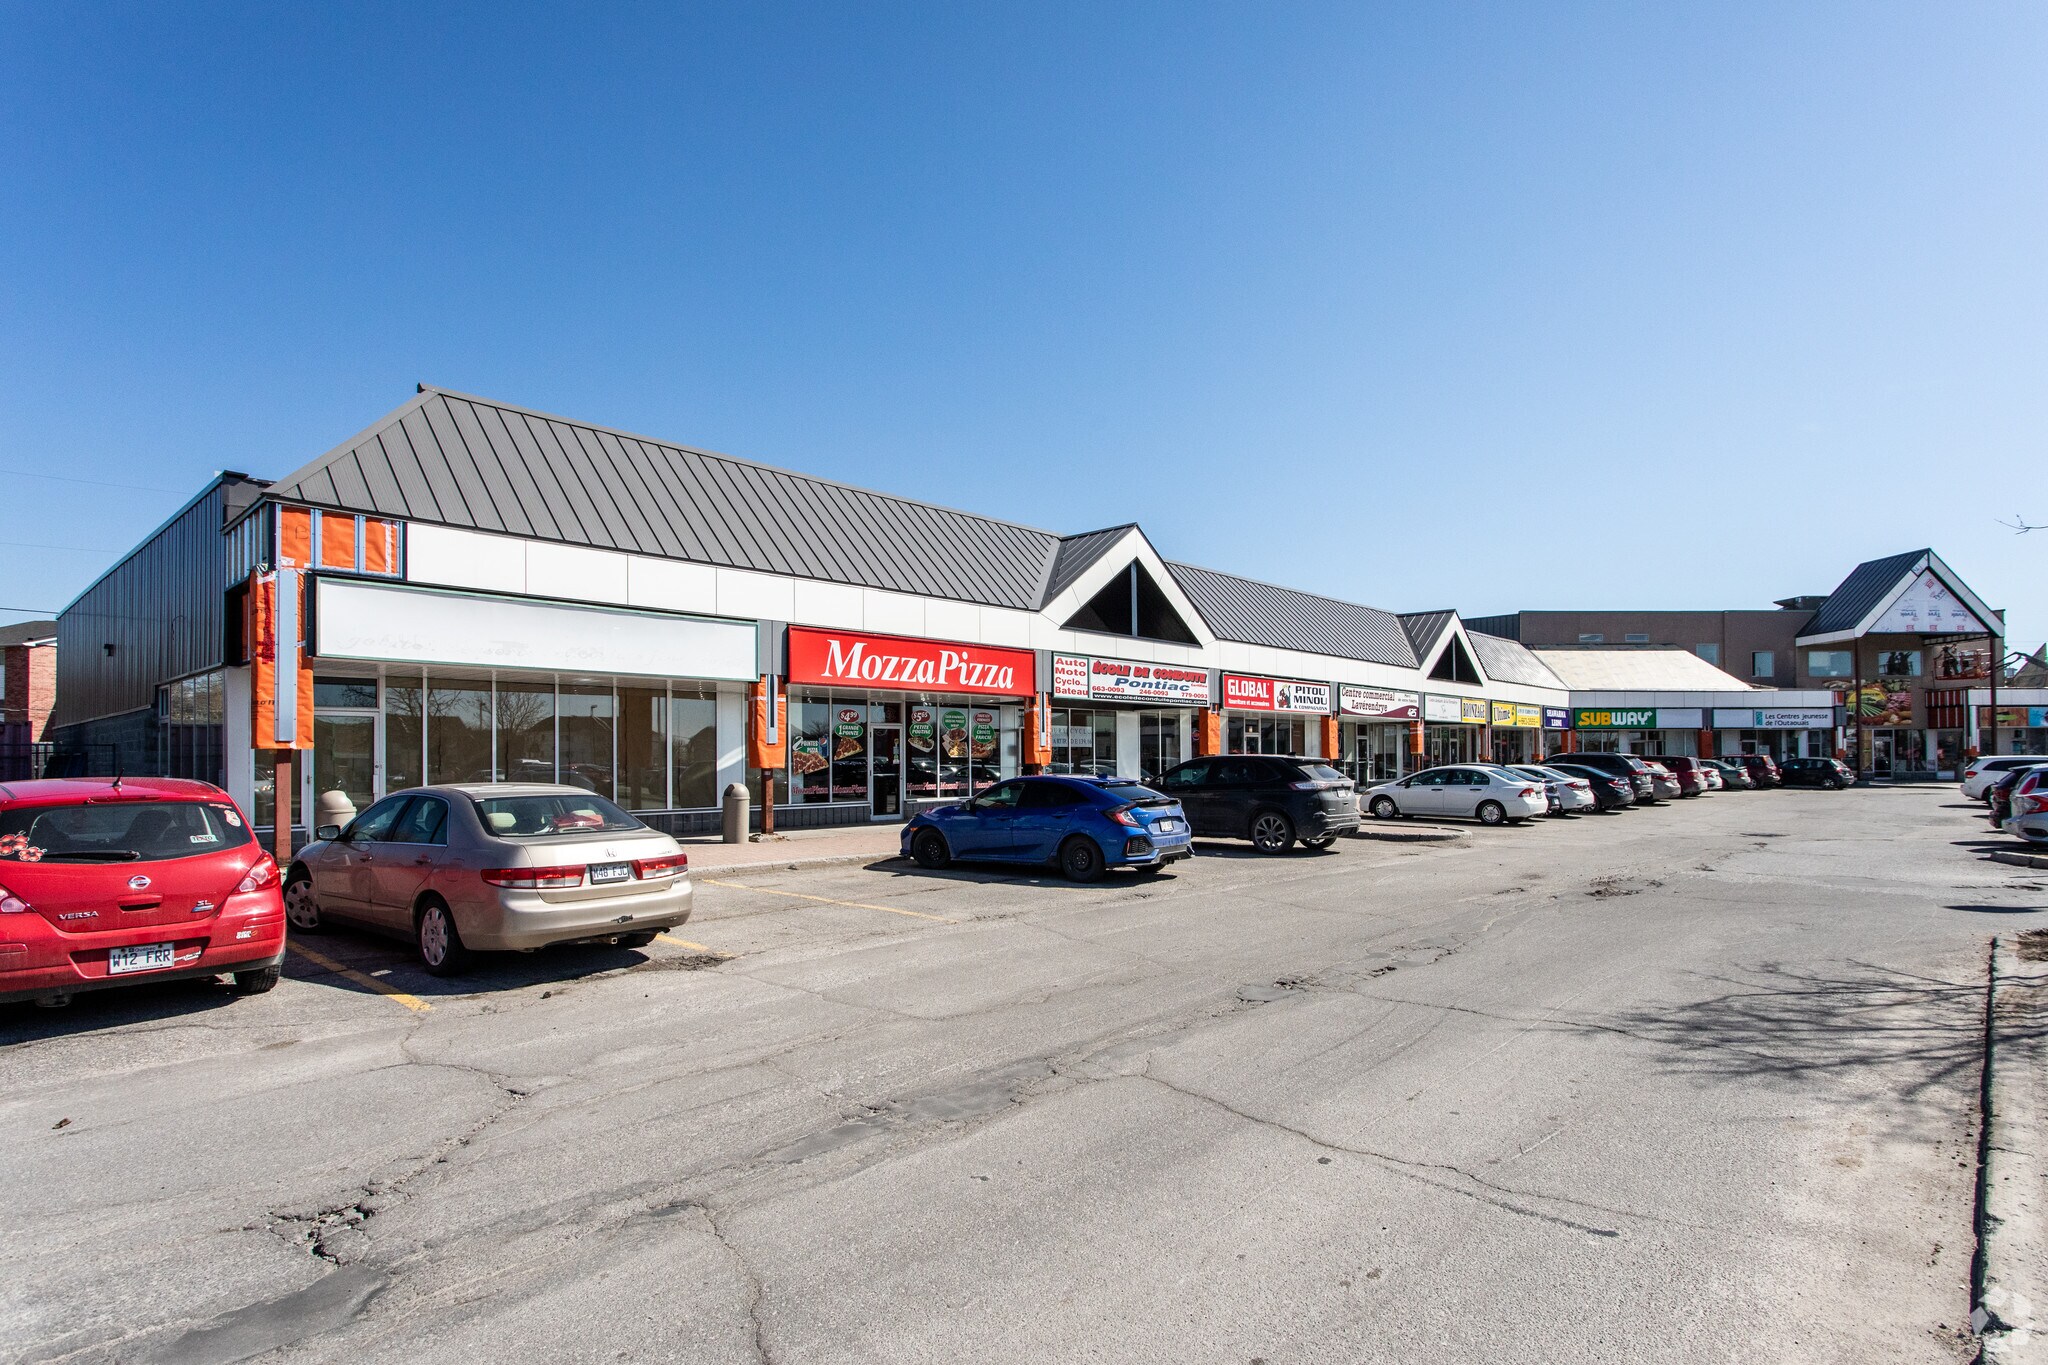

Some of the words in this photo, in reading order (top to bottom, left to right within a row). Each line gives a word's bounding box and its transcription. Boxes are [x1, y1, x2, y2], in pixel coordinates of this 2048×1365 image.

[821, 639, 1014, 689] MozzaPizza
[1055, 657, 1086, 668] Auto
[1055, 667, 1086, 677] Moto
[1092, 659, 1131, 677] ÉCOLE
[1133, 666, 1150, 679] DE
[1153, 668, 1208, 684] CONDUITE
[1055, 686, 1089, 696] Bateau
[1092, 685, 1125, 693] 663-0093
[1114, 678, 1190, 692] Pontiac
[1228, 678, 1269, 698] GLOBAL
[1295, 685, 1326, 696] PITOU
[1094, 693, 1207, 705] www.ecoledeconduitepontiac.com
[1341, 686, 1362, 698] Centre
[1362, 691, 1395, 701] commercial
[1294, 695, 1328, 706] MINOU
[1578, 710, 1653, 726] SUBWAY
[593, 866, 608, 879] M48
[57, 910, 99, 921] VERSA
[112, 952, 137, 968] W12
[146, 949, 171, 964] FRR
